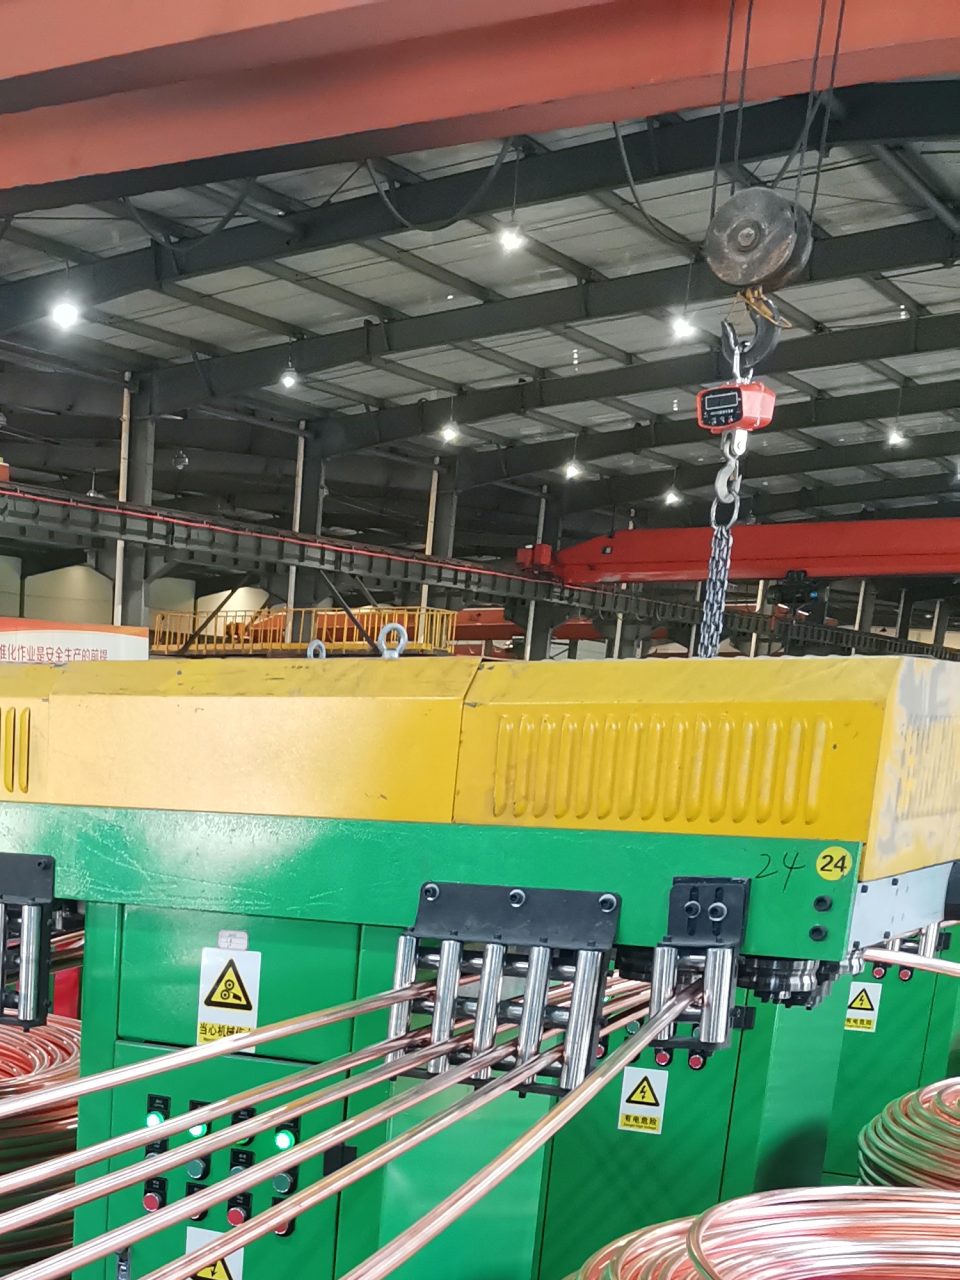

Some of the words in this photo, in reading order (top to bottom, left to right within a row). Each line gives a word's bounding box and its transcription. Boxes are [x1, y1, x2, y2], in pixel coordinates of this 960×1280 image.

[755, 852, 806, 893] 24
[820, 854, 847, 873] 24
[199, 1022, 251, 1038] 当心机械伤
